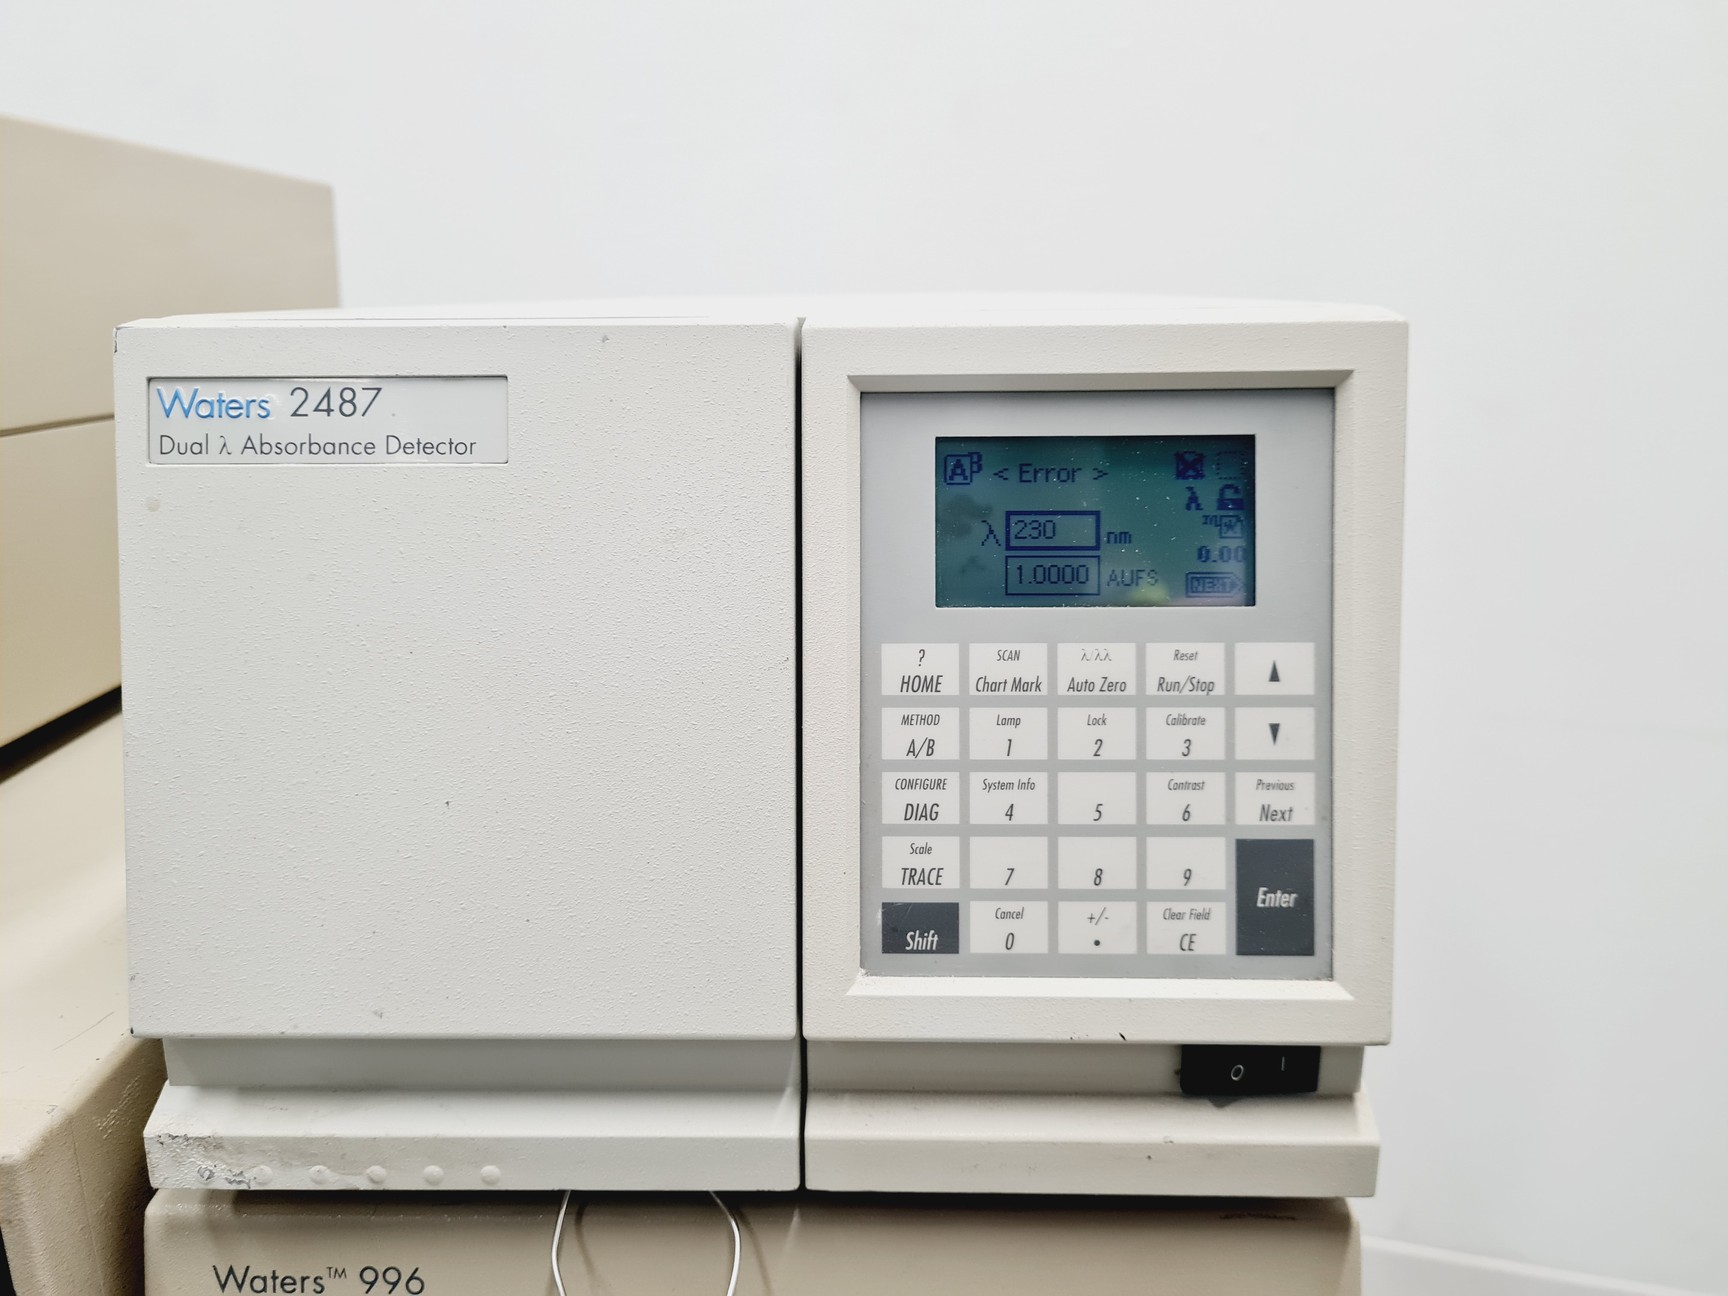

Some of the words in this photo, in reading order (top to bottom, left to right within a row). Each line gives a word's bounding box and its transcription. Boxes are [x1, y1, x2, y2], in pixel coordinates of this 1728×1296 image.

[156, 386, 271, 419] Waters
[290, 387, 382, 417] 2487
[159, 433, 209, 456] Dual
[218, 435, 232, 456] λ
[241, 433, 376, 456] Absorbance
[385, 434, 477, 456] Detector
[1018, 463, 1083, 484] Error
[1014, 519, 1057, 541] 230
[1106, 531, 1132, 545] nm
[1196, 545, 1247, 564] 0.00
[1016, 564, 1090, 586] 1.0000
[1106, 569, 1160, 588] AUFS
[917, 648, 926, 667] ?
[996, 649, 1021, 662] SCAN
[1173, 649, 1199, 662] Reset
[900, 675, 944, 693] HOME
[975, 675, 1008, 693] Chart
[1011, 675, 1043, 693] Mark
[1066, 676, 1096, 693] Auto
[1098, 676, 1128, 693] Zero
[1156, 675, 1216, 695] Run/Stop
[900, 713, 941, 726] METHOD
[996, 713, 1022, 729] Lamp
[1086, 713, 1108, 726] Lock
[1165, 713, 1207, 727] Calibrate
[905, 737, 936, 759] A/B
[1005, 738, 1013, 757] 1
[1092, 738, 1104, 757] 2
[1181, 738, 1192, 758] 3
[894, 778, 948, 791] CONFIGURE
[982, 778, 1015, 794] System
[1017, 777, 1036, 791] Info
[1167, 778, 1206, 791] Contrast
[1255, 778, 1295, 791] Previous
[903, 803, 940, 822] DIAG
[1004, 803, 1015, 822] 4
[1092, 803, 1104, 822] 5
[1181, 803, 1192, 822] 6
[1258, 804, 1294, 822] Next
[909, 842, 933, 855] Scale
[900, 867, 945, 886] TRACE
[1004, 867, 1016, 886] 7
[1093, 867, 1104, 887] 8
[1182, 868, 1193, 887] 9
[1256, 886, 1298, 908] Enter
[994, 906, 1025, 920] Cancel
[1162, 907, 1186, 921] Clear
[1188, 907, 1211, 921] Field
[904, 929, 939, 951] Shift
[1179, 932, 1197, 952] CE
[359, 1265, 426, 1296] 996
